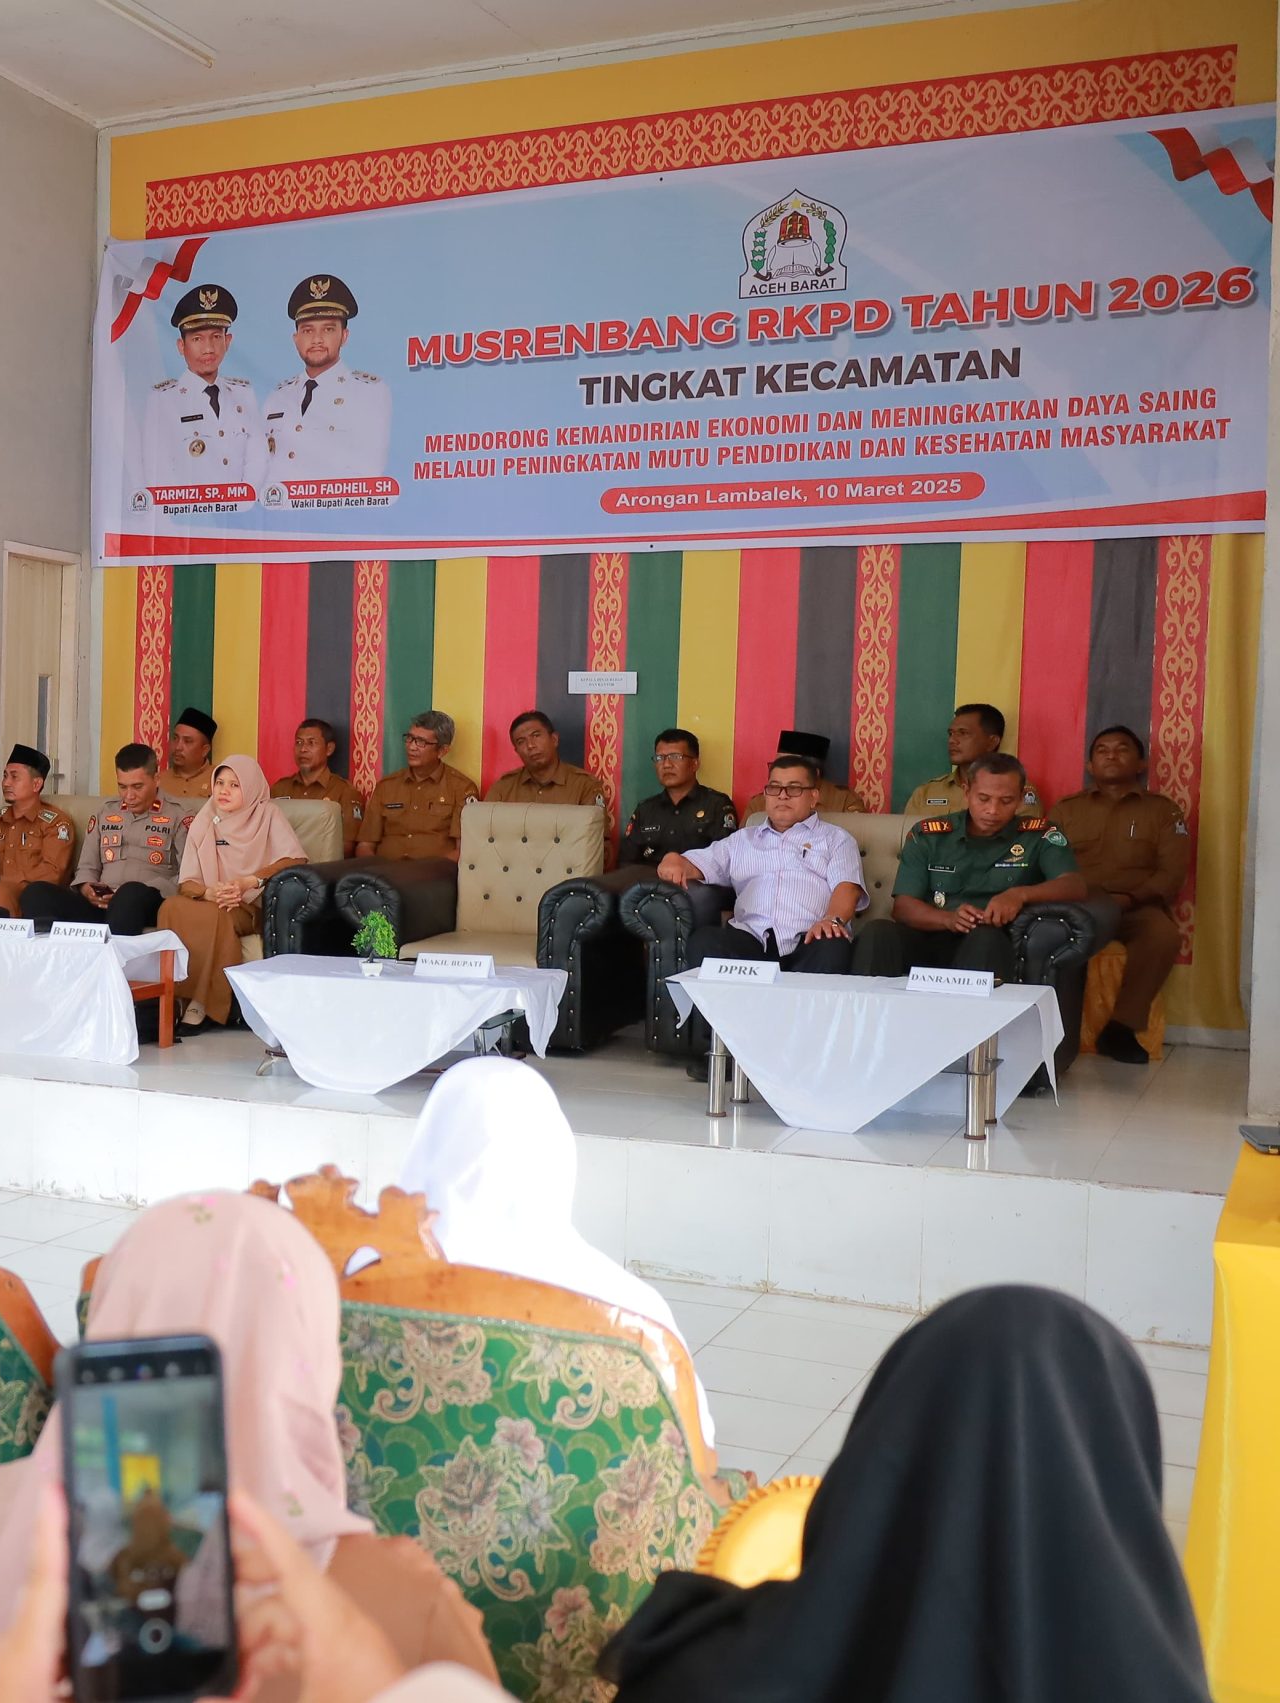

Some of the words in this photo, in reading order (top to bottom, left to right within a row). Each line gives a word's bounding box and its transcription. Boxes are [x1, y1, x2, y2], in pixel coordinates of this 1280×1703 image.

[748, 282, 787, 295] ACEH
[790, 278, 838, 292] BARAT
[406, 310, 736, 367] MUSRENBANG
[747, 299, 892, 341] RKPD
[901, 280, 1095, 329] TAHUN
[1107, 266, 1255, 313] 2026
[579, 366, 747, 405] TINGKAT
[756, 346, 1021, 395] KECAMATAN
[424, 428, 549, 453] MENDORONG
[556, 420, 700, 446] KEMANDIRIAN
[707, 413, 810, 438] EKONOMI
[817, 410, 863, 432] DAN
[871, 399, 1059, 429] MENINGKATKAN
[1067, 394, 1130, 418] DAYA
[1138, 388, 1217, 414] SAING
[413, 459, 496, 480] MELALUI
[503, 451, 641, 476] PENINGKATAN
[648, 448, 709, 469] MUTU
[717, 440, 851, 466] PENDIDIKAN
[859, 437, 906, 459] DAN
[914, 429, 1052, 456] KESEHATAN
[1060, 418, 1232, 448] MASYARAKAT
[155, 488, 203, 501] TARMIZI,
[205, 487, 224, 500] SP.,
[227, 485, 248, 498] MM
[289, 484, 318, 496] SAID
[320, 481, 372, 495] FADHEIL,
[375, 480, 392, 493] SH
[616, 492, 699, 508] Arongan
[705, 485, 808, 504] Lambalek,
[815, 484, 839, 499] 10
[846, 481, 905, 498] Maret
[911, 478, 962, 495] 2025
[163, 504, 190, 515] Bupati
[192, 503, 213, 513] Aceh
[215, 503, 238, 512] Barat
[291, 498, 315, 509] Wakil
[316, 498, 342, 509] Bupati
[344, 497, 365, 507] Aceh
[367, 496, 389, 506] Barat
[144, 824, 171, 835] POLRI
[52, 926, 105, 939] BAPPEDA
[421, 958, 449, 967] WAKIL
[451, 960, 482, 968] BUPATI
[718, 964, 760, 976] DPRK
[911, 974, 973, 986] DANRAMIL
[976, 978, 988, 986] 08
